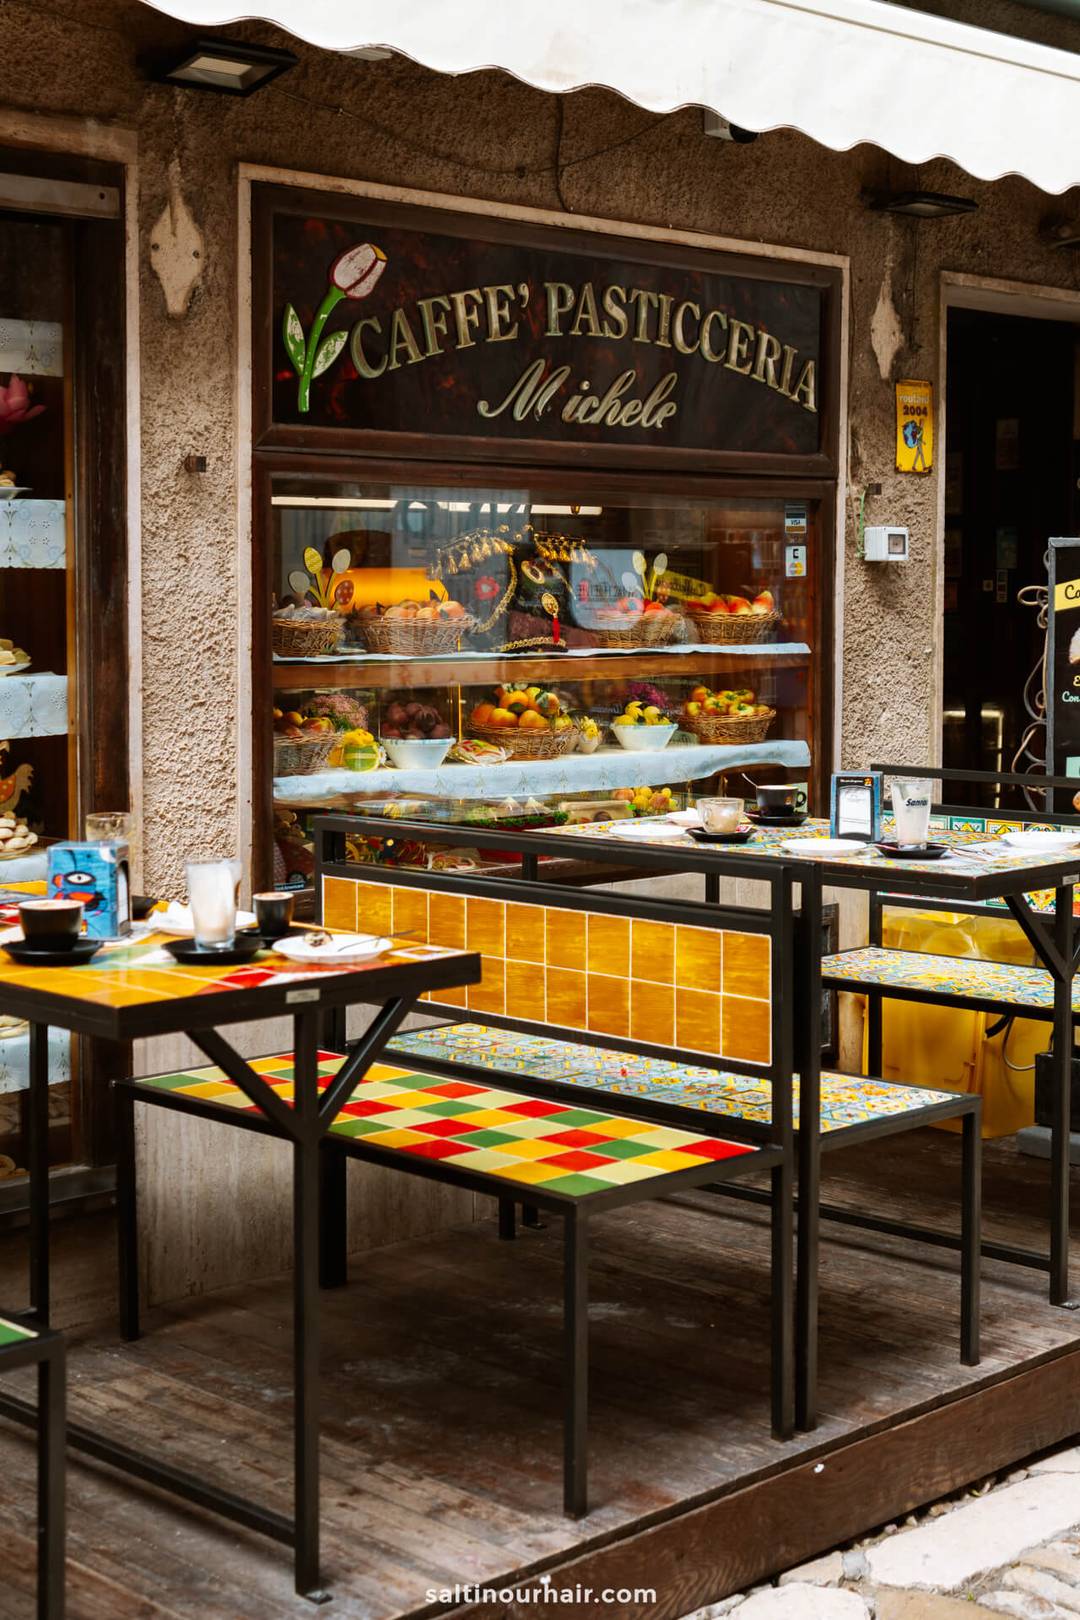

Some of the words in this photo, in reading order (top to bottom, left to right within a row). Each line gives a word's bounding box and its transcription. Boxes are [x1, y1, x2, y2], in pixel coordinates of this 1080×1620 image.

[543, 282, 818, 413] PASTICCERIA
[477, 358, 678, 428] Michele
[903, 405, 928, 416] 2004
